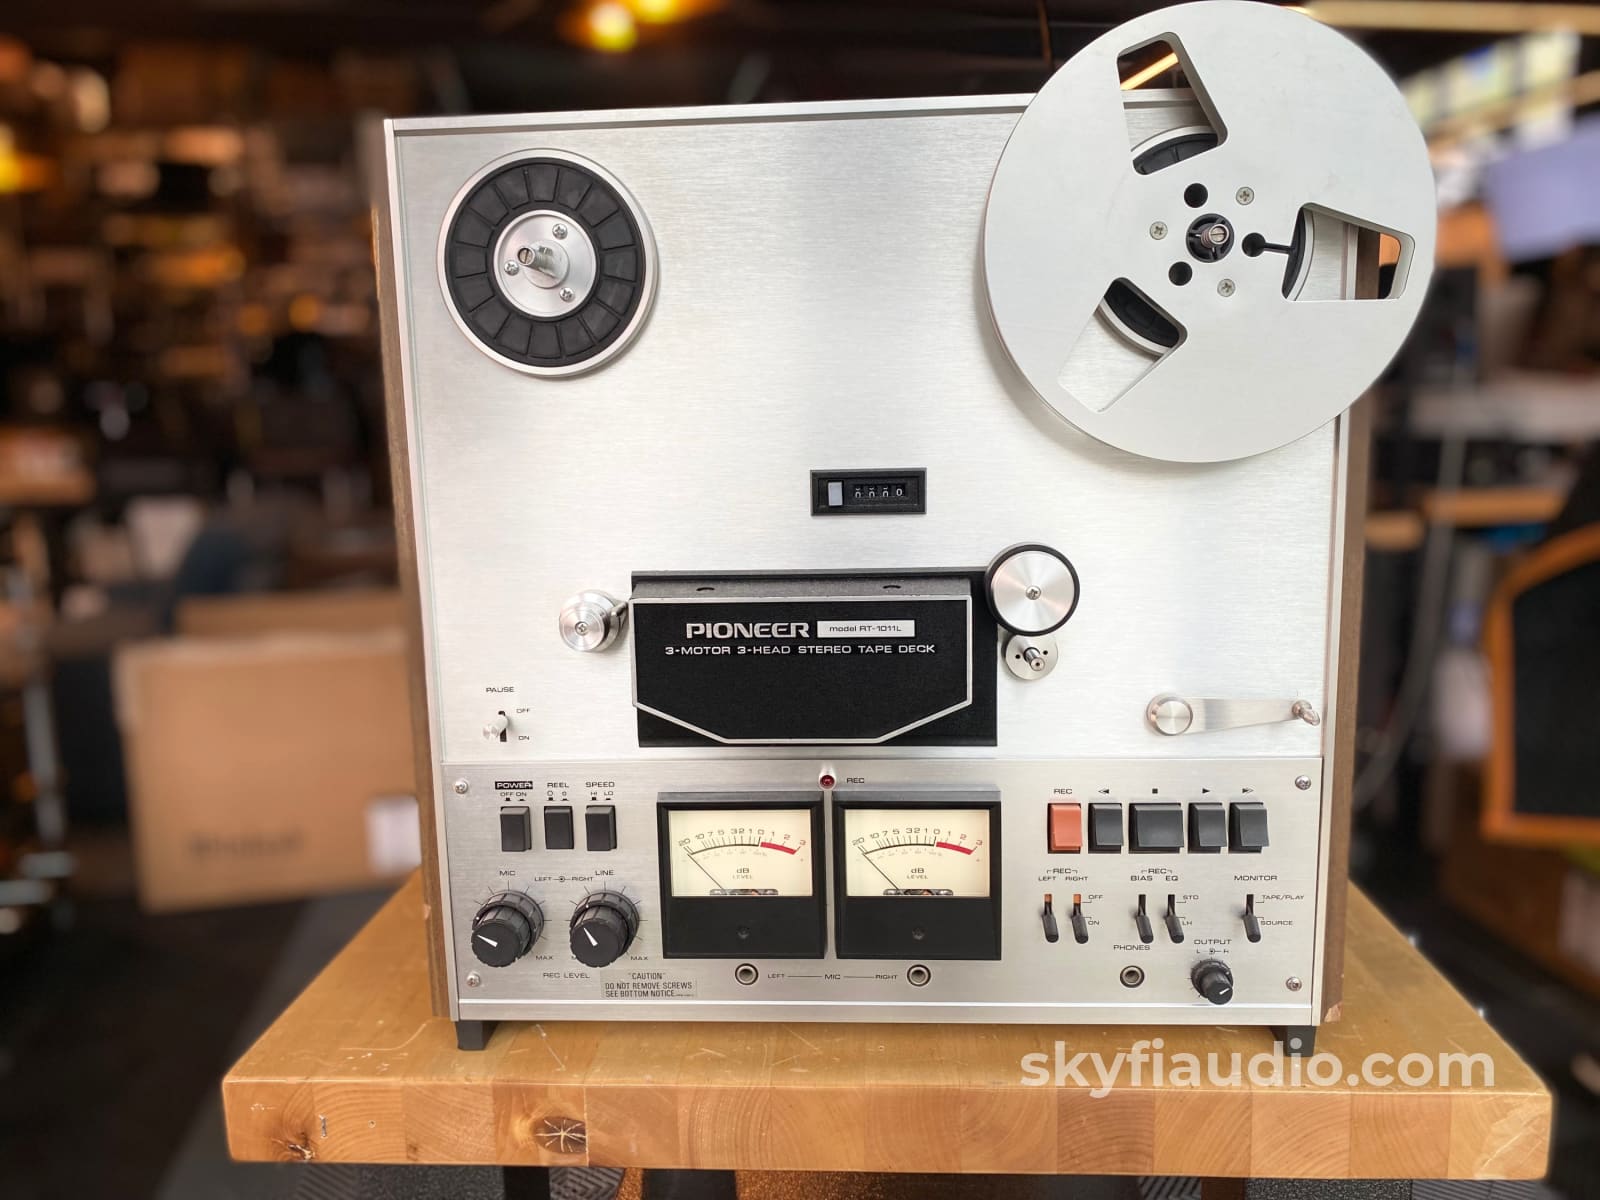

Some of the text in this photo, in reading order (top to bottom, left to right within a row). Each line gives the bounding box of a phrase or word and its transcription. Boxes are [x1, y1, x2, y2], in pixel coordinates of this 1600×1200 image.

[686, 622, 810, 639] PIONEER
[829, 624, 902, 632] model RT-1011L
[665, 644, 936, 655] 3-MOTOR 3-HEAD STEREO TAPE DECK
[679, 838, 691, 847] 20
[852, 837, 865, 846] 20
